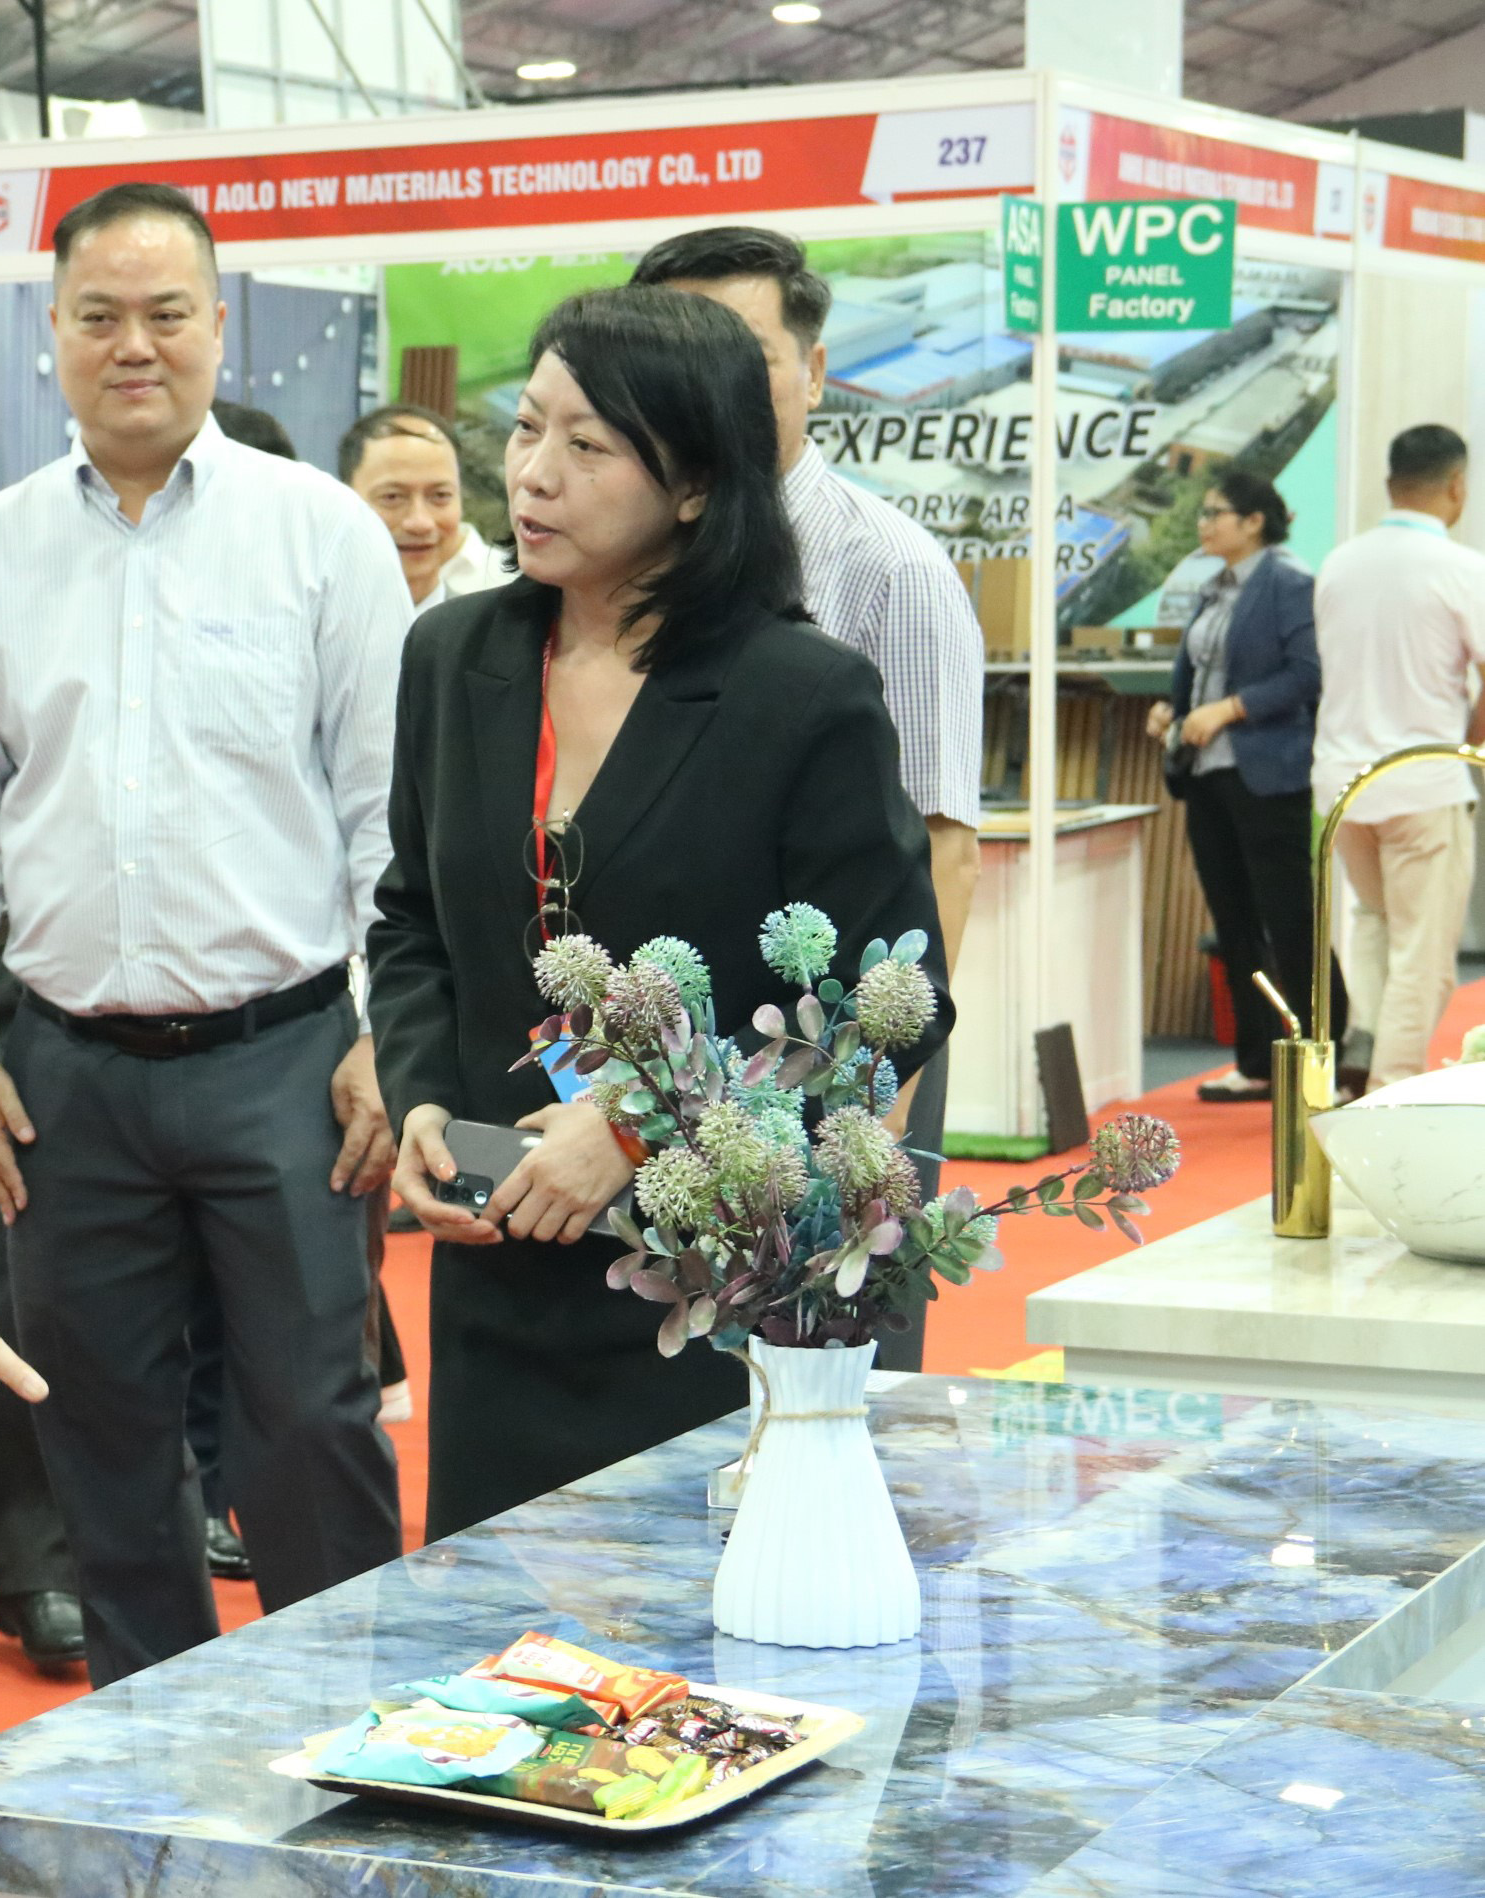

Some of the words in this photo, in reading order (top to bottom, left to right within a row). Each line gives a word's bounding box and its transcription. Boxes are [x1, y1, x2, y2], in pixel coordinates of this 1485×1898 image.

[938, 136, 987, 166] 237
[214, 181, 276, 213] AOLO
[281, 176, 340, 209] NEW
[345, 167, 483, 205] MATERIALS
[489, 156, 652, 196] TECHNOLOGY
[658, 153, 710, 187] CO.,
[716, 148, 763, 182] LTD
[1007, 203, 1041, 256] ASA
[1071, 203, 1223, 256] WPC
[1105, 265, 1184, 286] PANEL
[1088, 293, 1196, 324] Factory
[806, 410, 1157, 464] EXPERIENCE
[980, 494, 1074, 523] ARA
